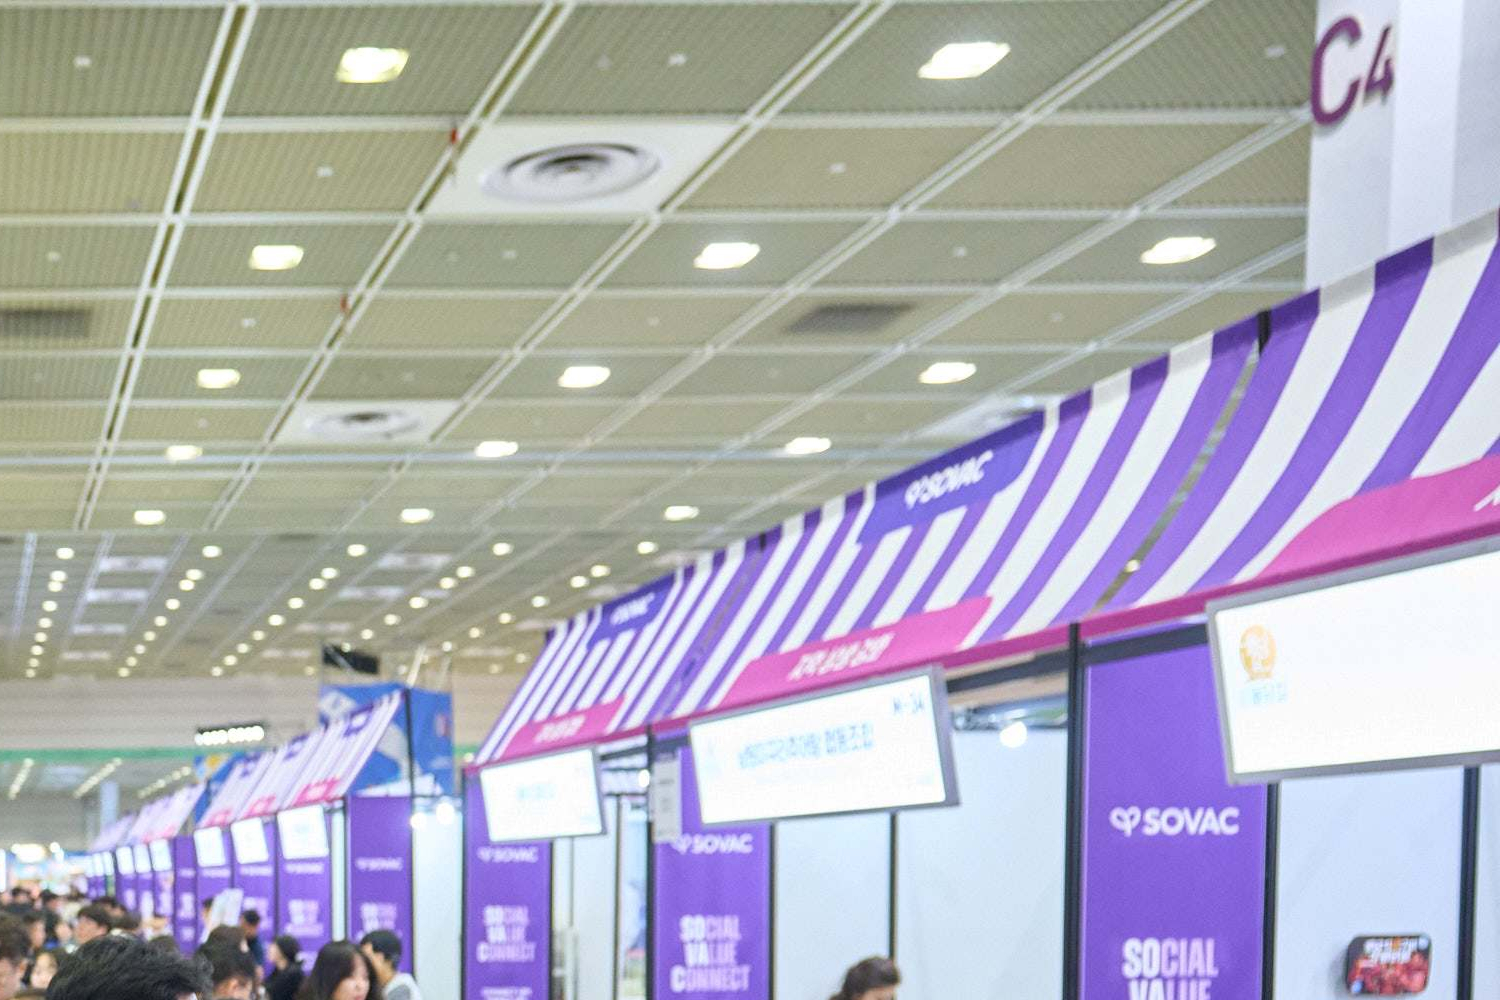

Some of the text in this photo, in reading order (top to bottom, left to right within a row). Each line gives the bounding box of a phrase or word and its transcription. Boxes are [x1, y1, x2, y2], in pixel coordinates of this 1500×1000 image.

[1142, 806, 1240, 836] SOVAC
[691, 833, 753, 854] SOVAC
[679, 914, 742, 941] SOCIAL
[683, 941, 738, 966] VALUE
[1122, 937, 1219, 979] SOCIAL
[670, 965, 751, 993] CONNECT
